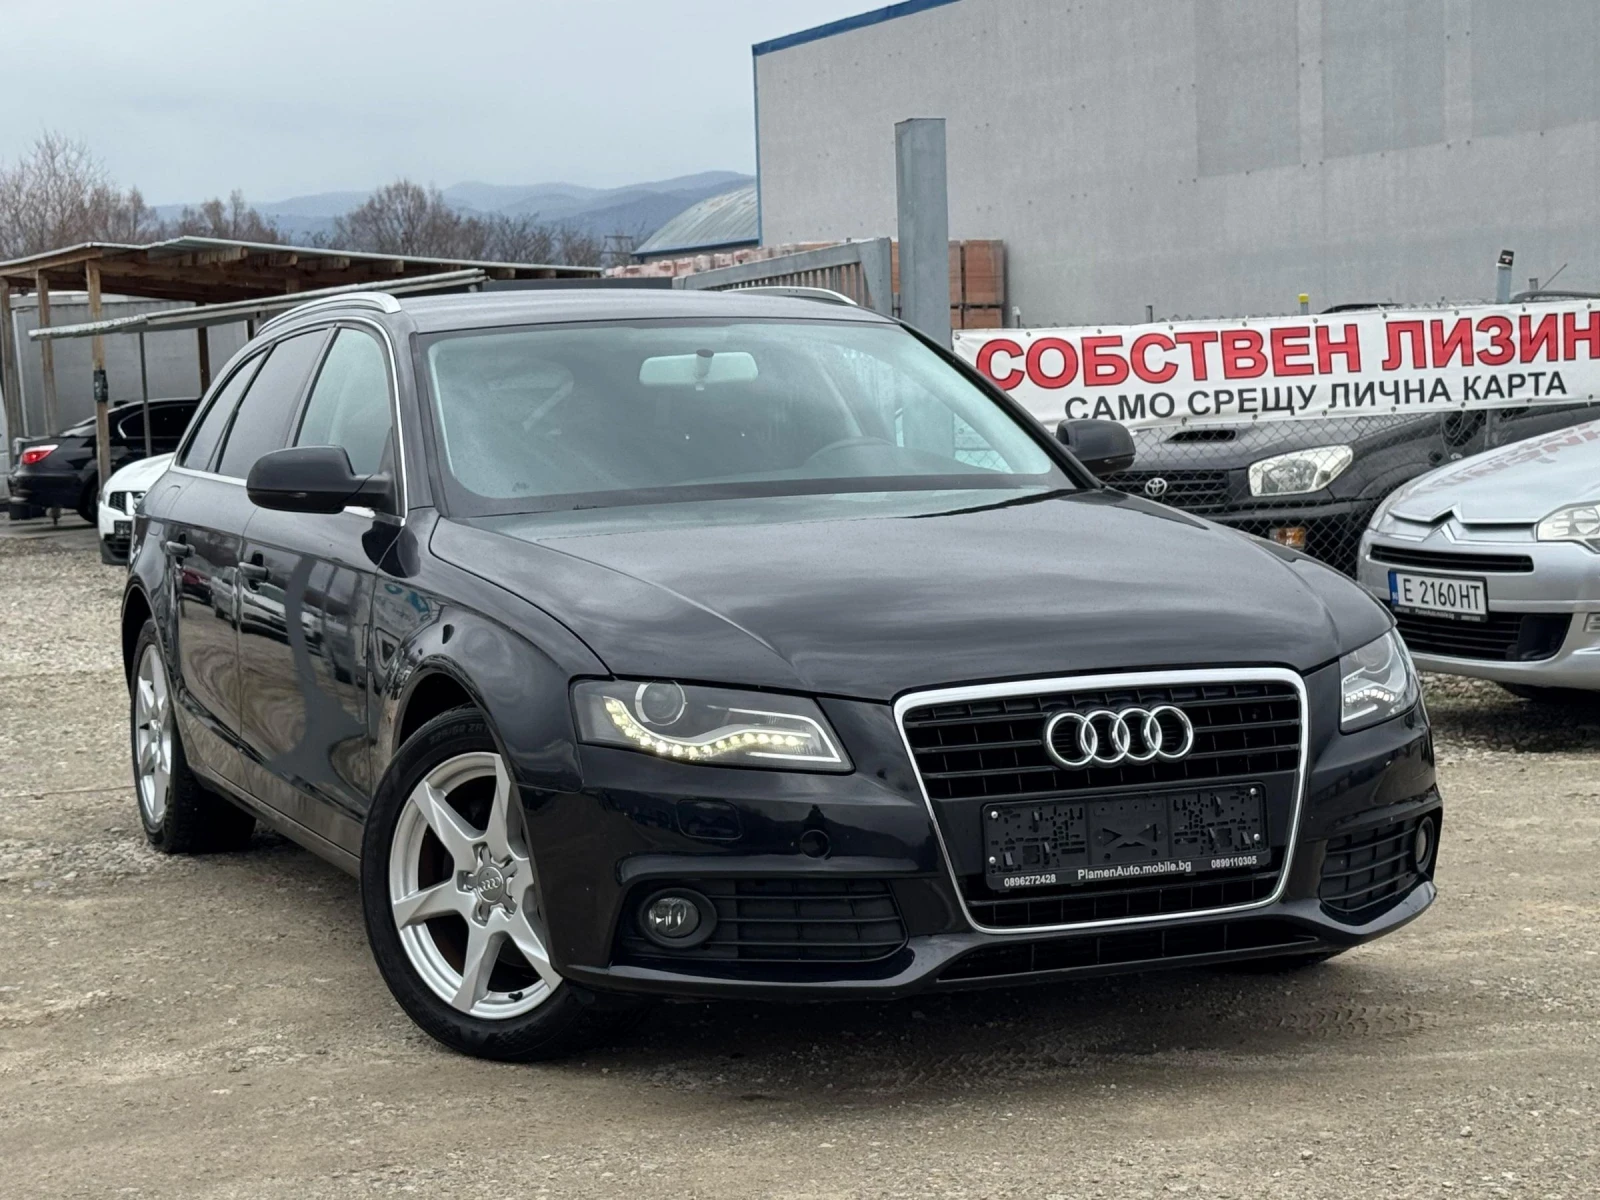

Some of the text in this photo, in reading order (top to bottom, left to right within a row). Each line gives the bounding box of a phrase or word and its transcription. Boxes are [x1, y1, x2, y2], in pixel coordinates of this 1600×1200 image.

[976, 311, 1600, 391] СОБСТВЕН ЛИЗИН
[1064, 371, 1567, 420] САМО СРЕЩУ ЛИЧНА КАРТА
[1004, 873, 1056, 887] 0896272428
[1077, 860, 1191, 880] PlamenAuto.mobile.bg
